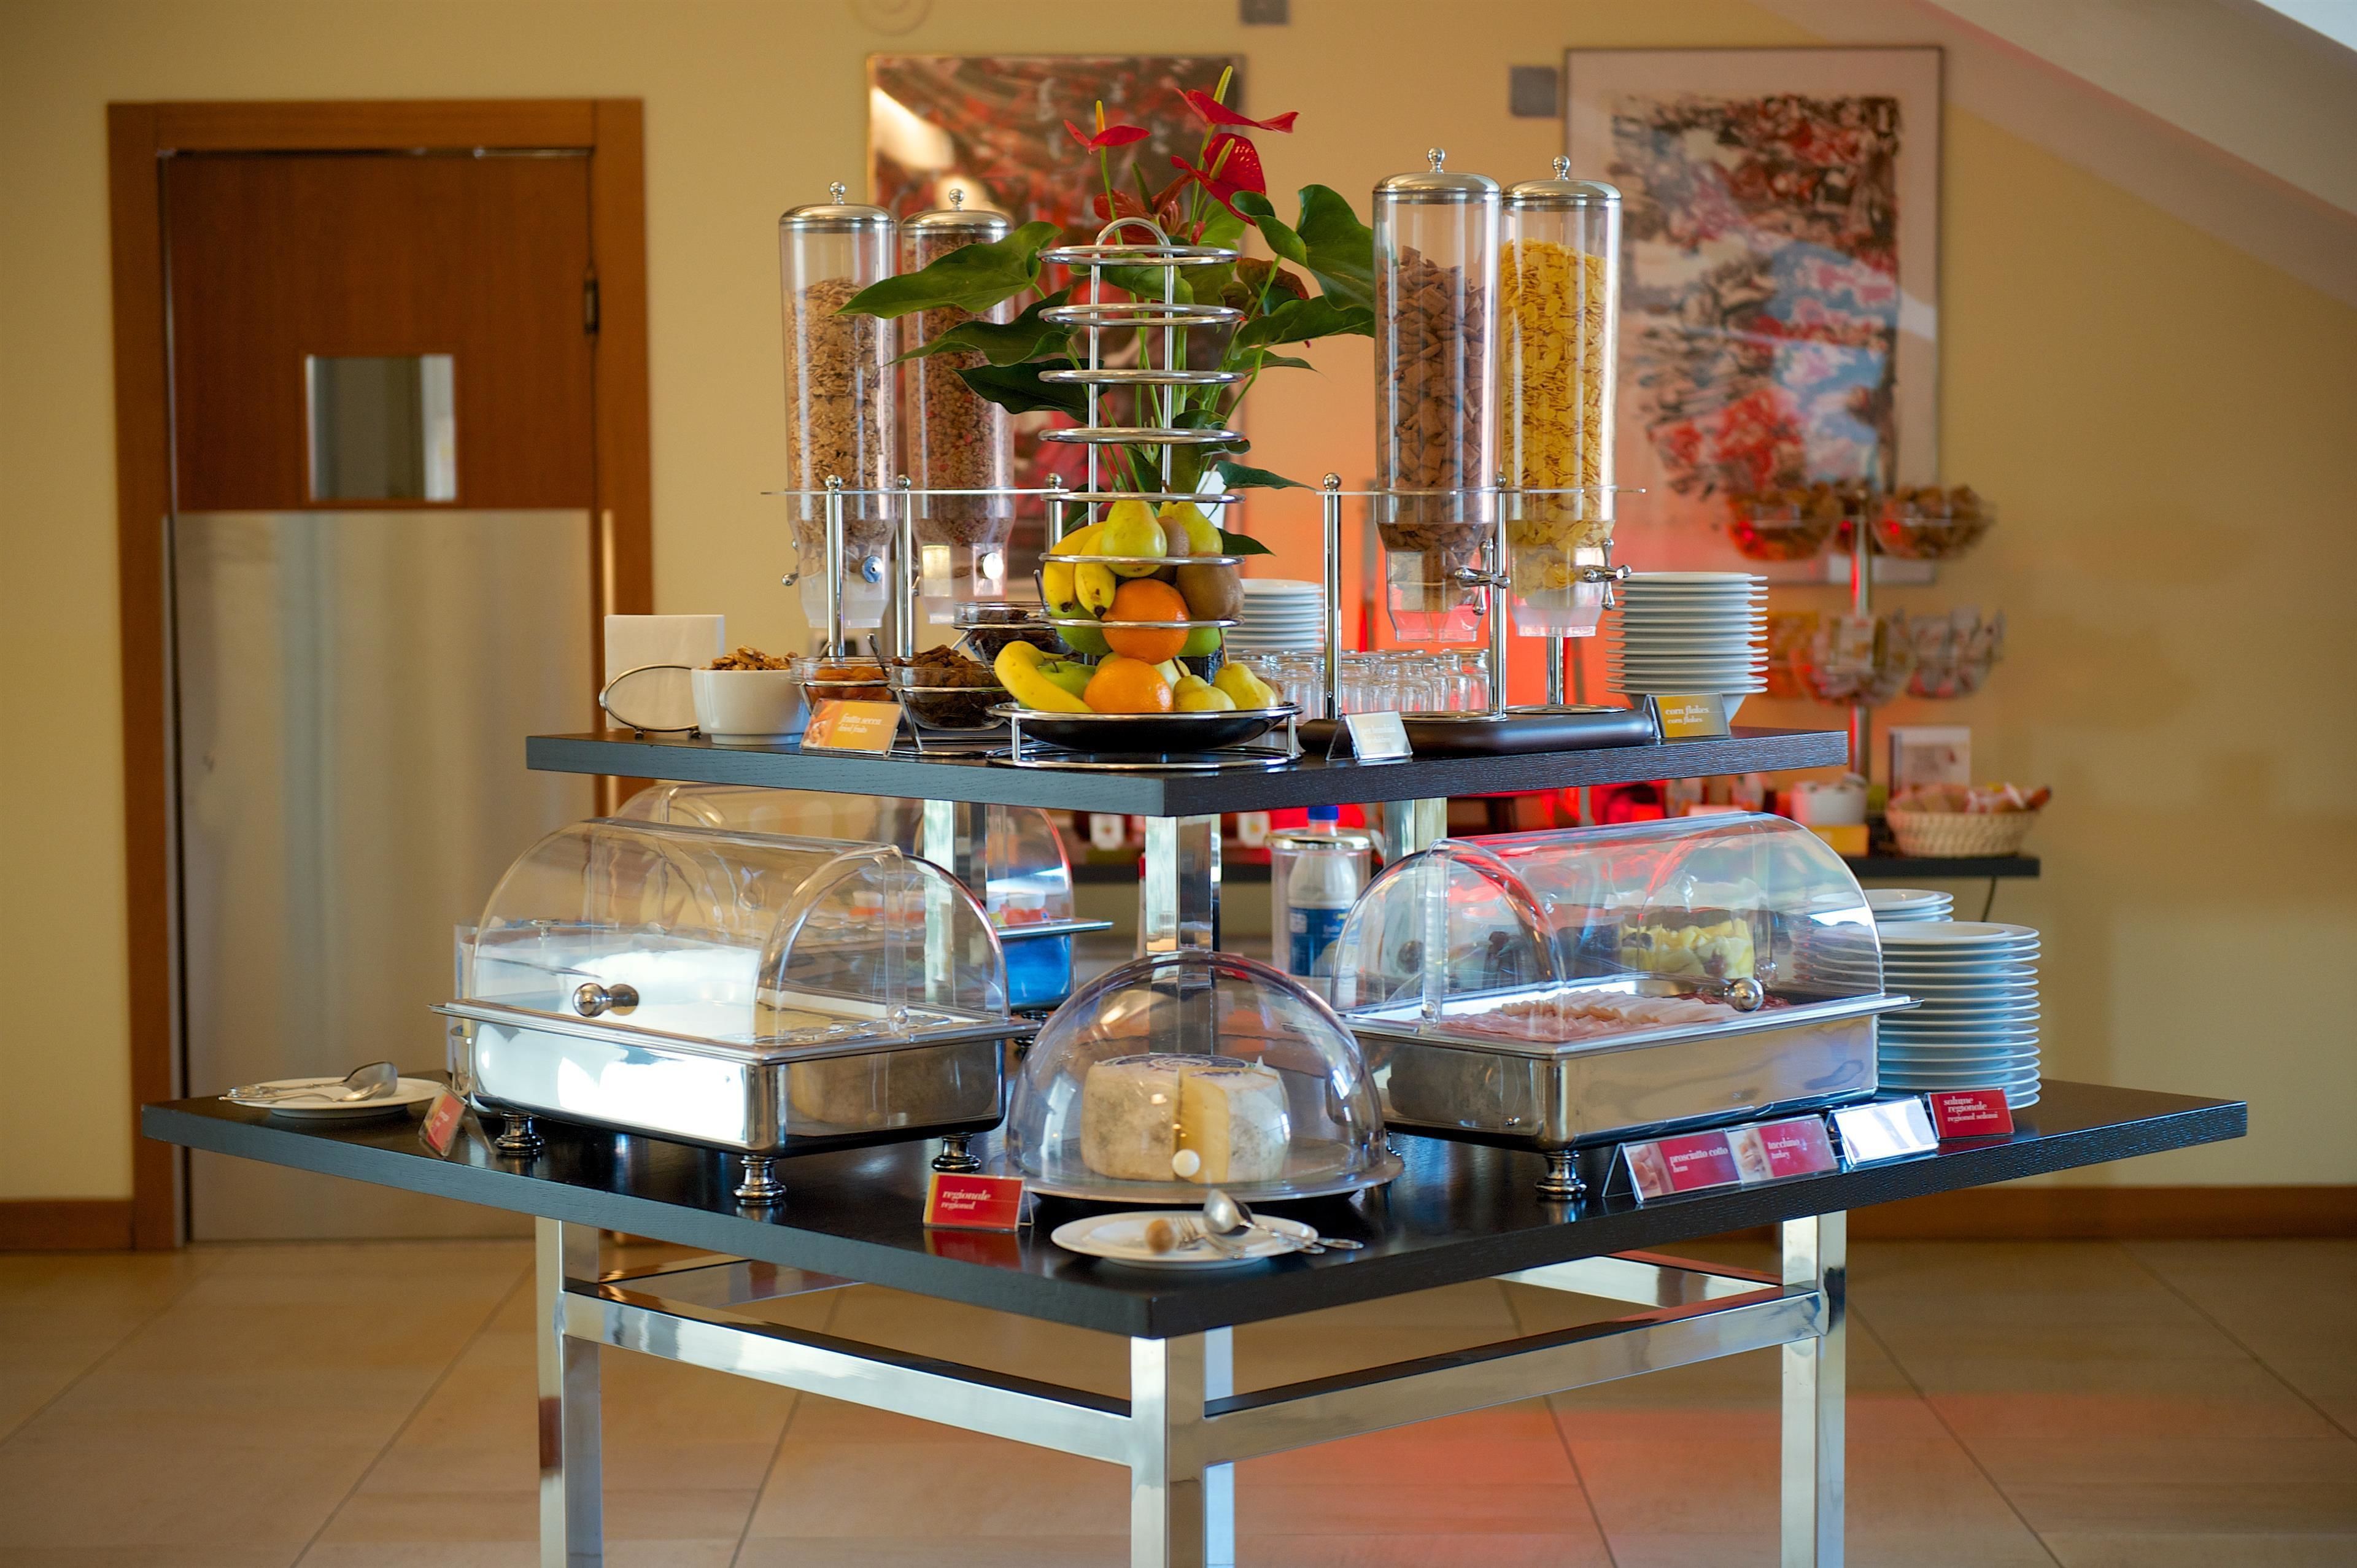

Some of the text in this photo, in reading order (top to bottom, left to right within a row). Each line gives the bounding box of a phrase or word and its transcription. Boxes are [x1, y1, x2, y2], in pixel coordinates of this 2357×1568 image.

[1685, 706, 1709, 716] flakes
[1683, 716, 1703, 725] flakes
[1948, 1100, 1987, 1113] regionale
[1948, 1113, 1975, 1123] regional
[1670, 1146, 1728, 1166] prosciutto cotto
[942, 1189, 990, 1201] regionale
[941, 1201, 976, 1211] regional
